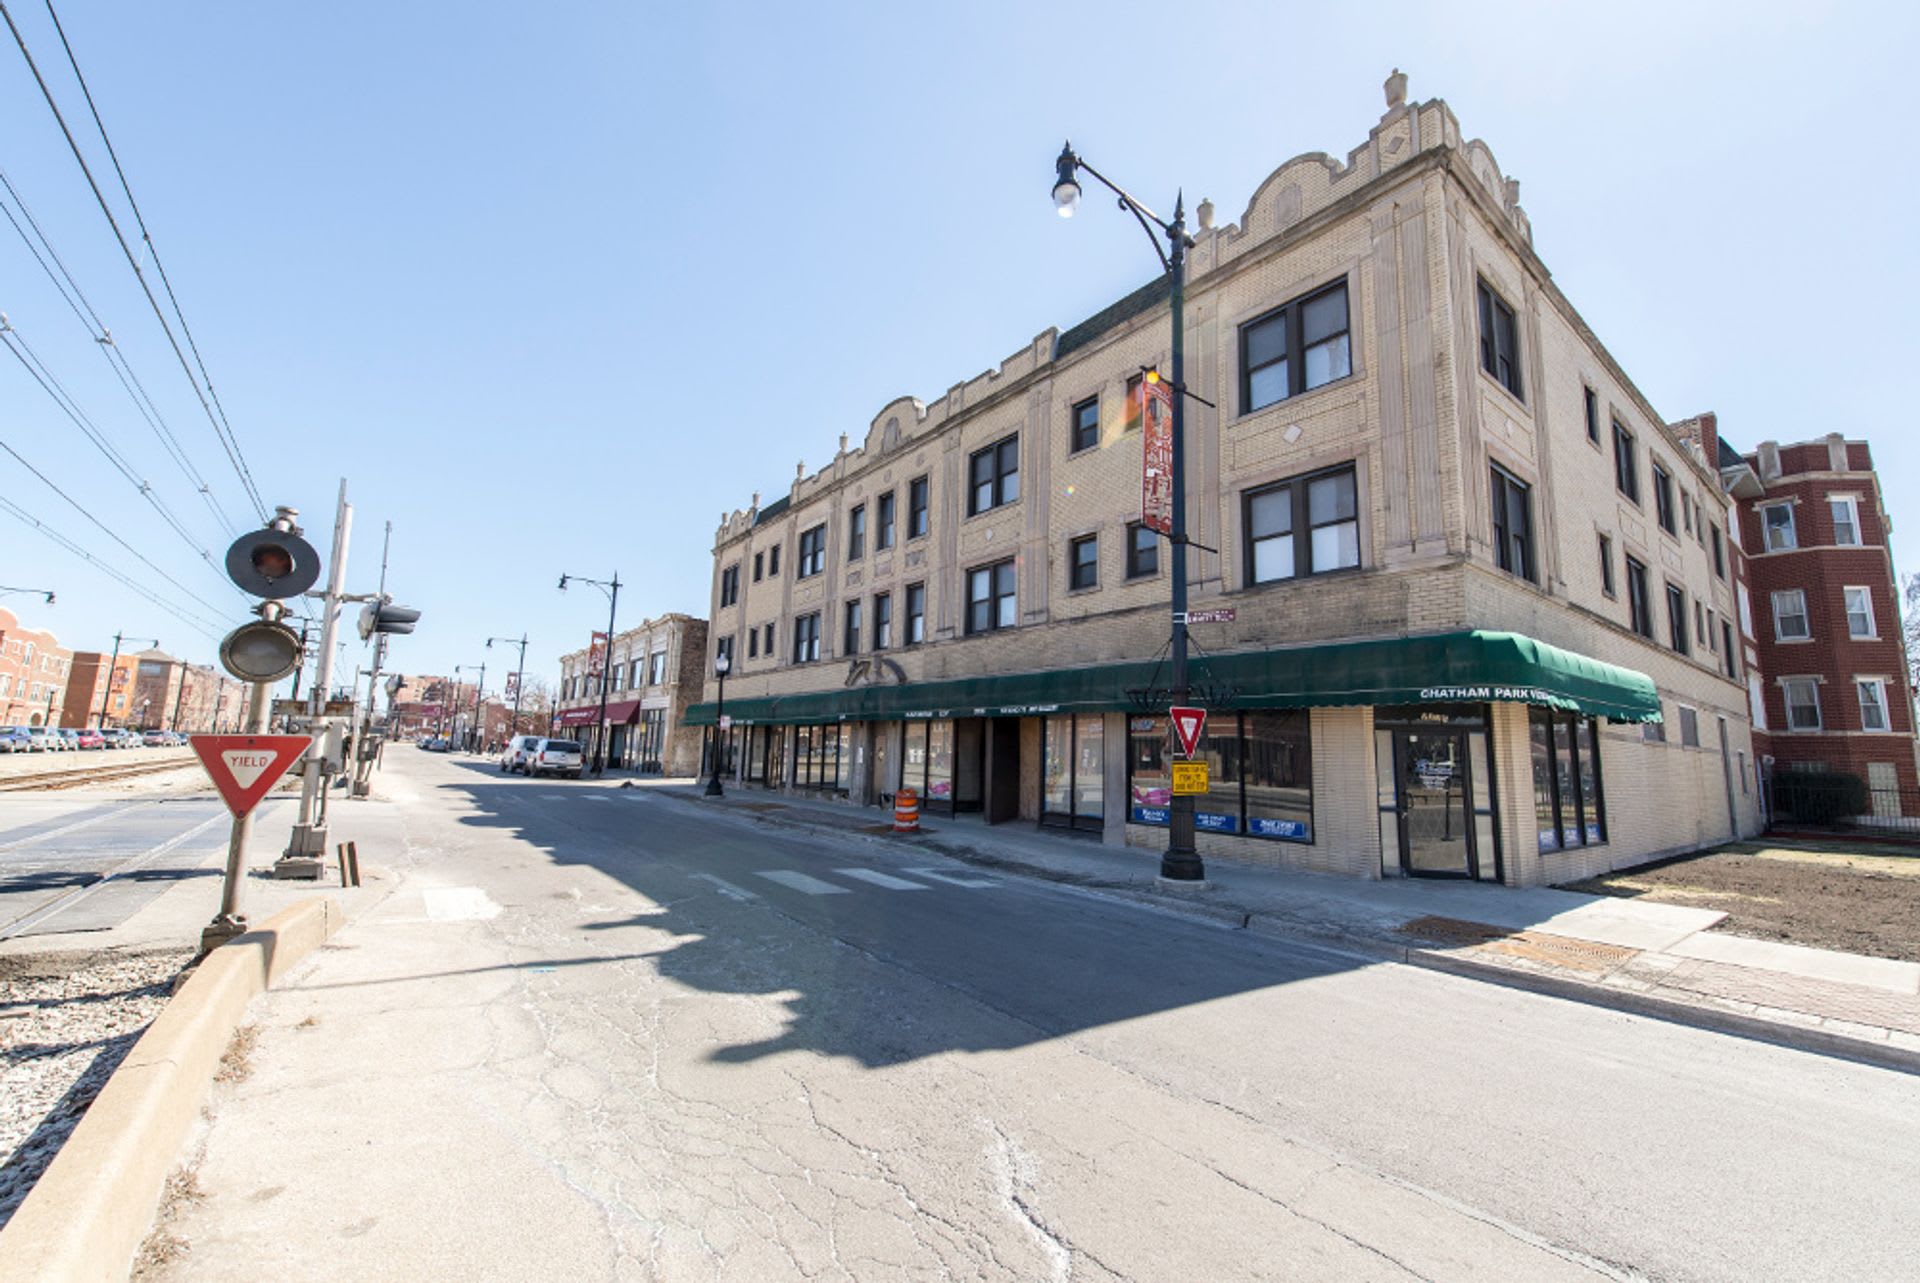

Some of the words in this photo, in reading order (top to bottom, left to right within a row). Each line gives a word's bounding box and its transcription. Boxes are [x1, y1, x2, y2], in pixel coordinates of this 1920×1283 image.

[1420, 687, 1490, 699] CHATHAM
[1494, 687, 1529, 698] PARK
[230, 756, 268, 768] YIELD
